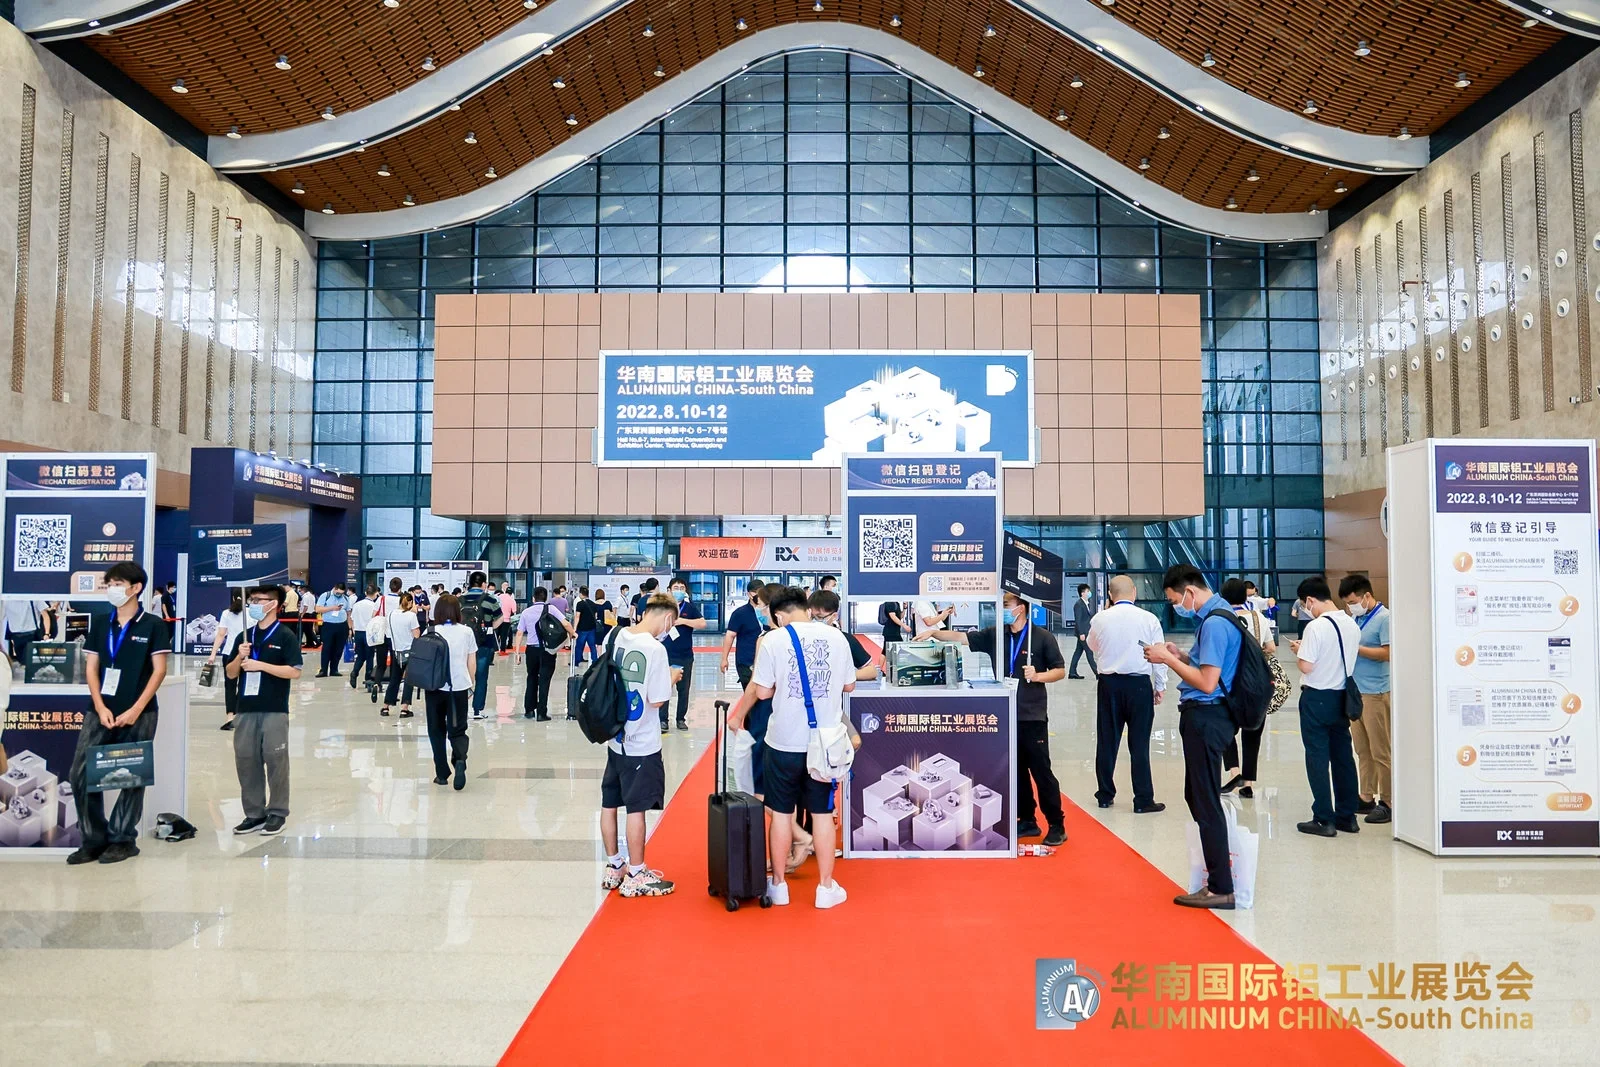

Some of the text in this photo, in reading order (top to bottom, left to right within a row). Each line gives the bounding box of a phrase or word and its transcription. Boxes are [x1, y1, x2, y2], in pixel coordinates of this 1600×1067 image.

[617, 364, 814, 384] 华南国际铝工业展览会
[617, 384, 814, 396] ALUMINIUM CHINA-South China
[616, 404, 728, 420] 2022.8.10-12
[38, 465, 116, 477] 微信扫码登记
[881, 464, 961, 476] 微信扫码登记
[1466, 462, 1578, 474] 华南国际铝工业展览会
[1446, 492, 1522, 504] 2022.8.10-12
[1470, 521, 1557, 534] 微信登记引导
[698, 548, 739, 559] 欢迎莅临
[776, 546, 800, 562] RX
[1460, 556, 1465, 568] 1
[1565, 600, 1572, 612] 2
[1460, 651, 1468, 662] 3
[1566, 698, 1575, 709] 4
[884, 714, 998, 726] 华南国际铝工业展览会
[1462, 750, 1470, 762] 5
[1496, 830, 1512, 840] RX
